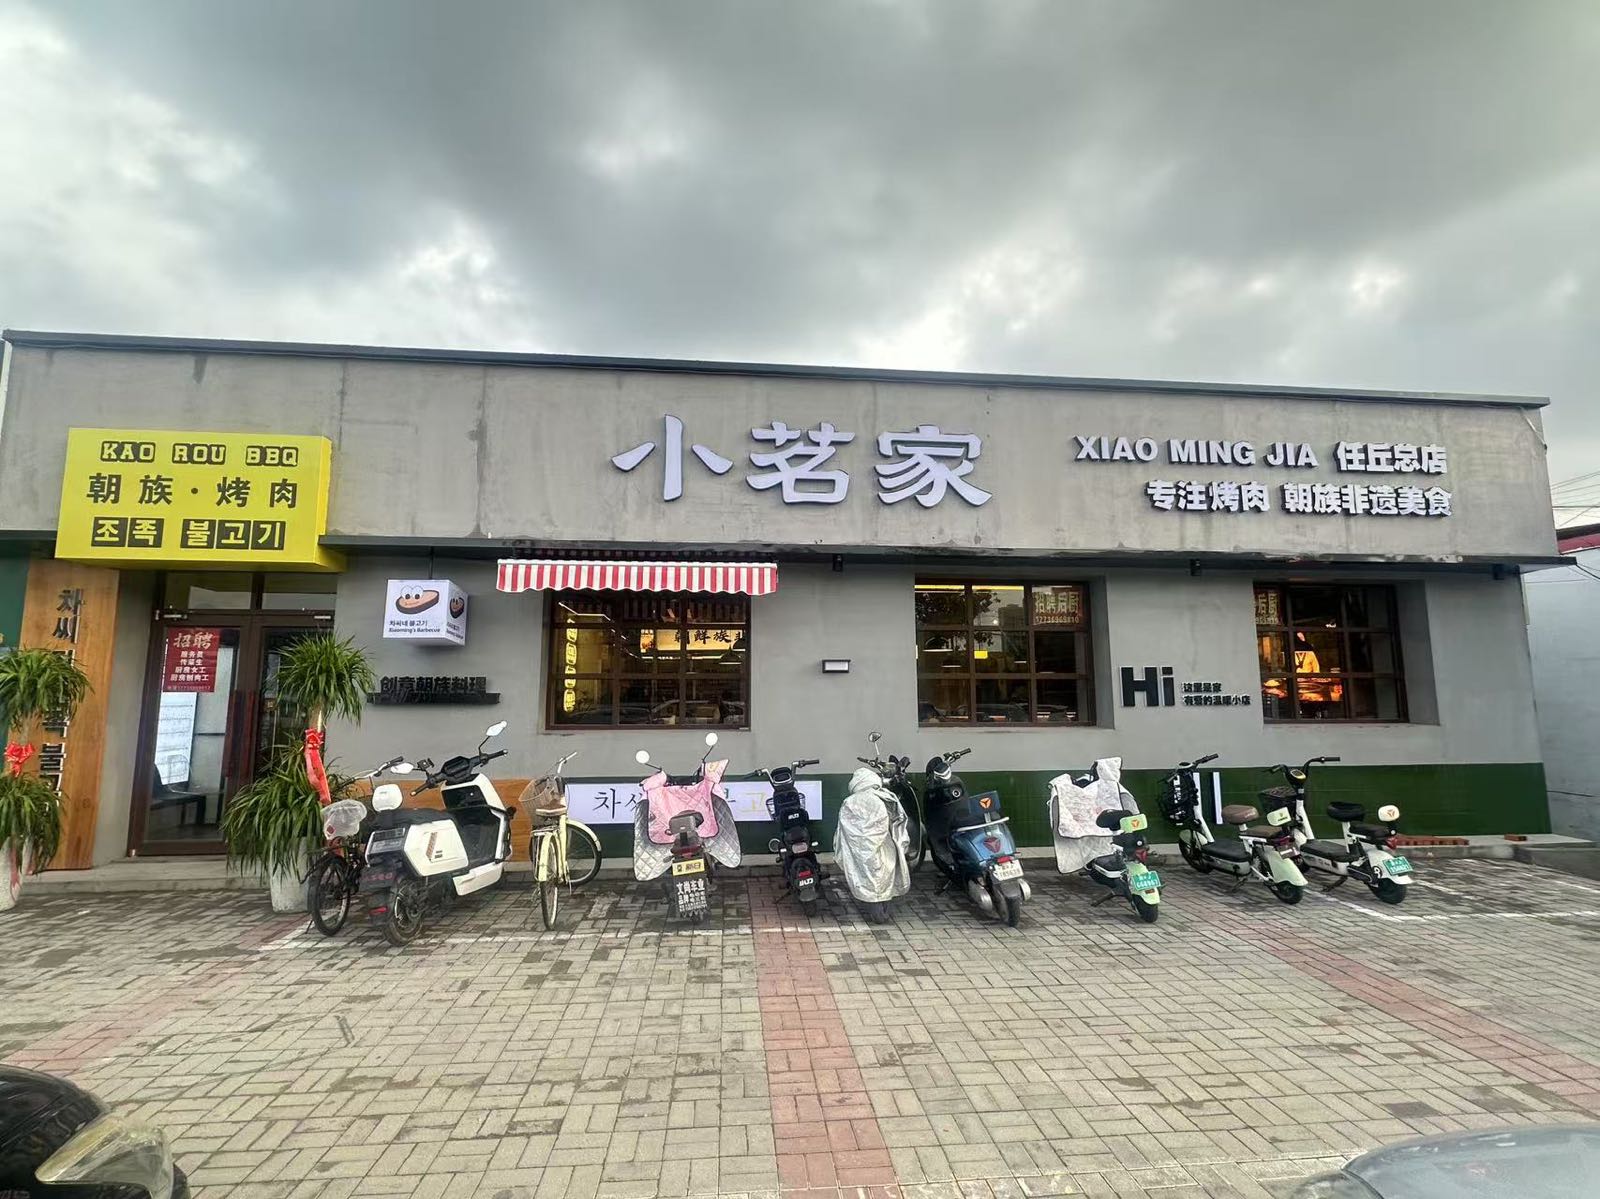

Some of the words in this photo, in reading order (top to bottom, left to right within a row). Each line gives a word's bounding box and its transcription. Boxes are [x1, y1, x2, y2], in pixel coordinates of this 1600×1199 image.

[101, 441, 156, 463] KAO
[172, 443, 226, 465] ROU
[245, 446, 299, 467] BBQ
[611, 413, 993, 508] 小茗家
[1074, 435, 1159, 462] XIAO
[1167, 438, 1256, 466] MING
[1263, 442, 1319, 468] JIA
[1336, 441, 1448, 475] 任丘总店
[1145, 480, 1270, 513] 专注烤肉
[1281, 482, 1452, 516] 朝族非遗美食
[91, 517, 164, 548] 조족
[180, 519, 286, 550] 불고기
[173, 631, 213, 650] 招聘
[1120, 666, 1176, 707] Hi
[1182, 682, 1222, 693] 这里是家
[1183, 695, 1251, 706] 有爱的温暖小店
